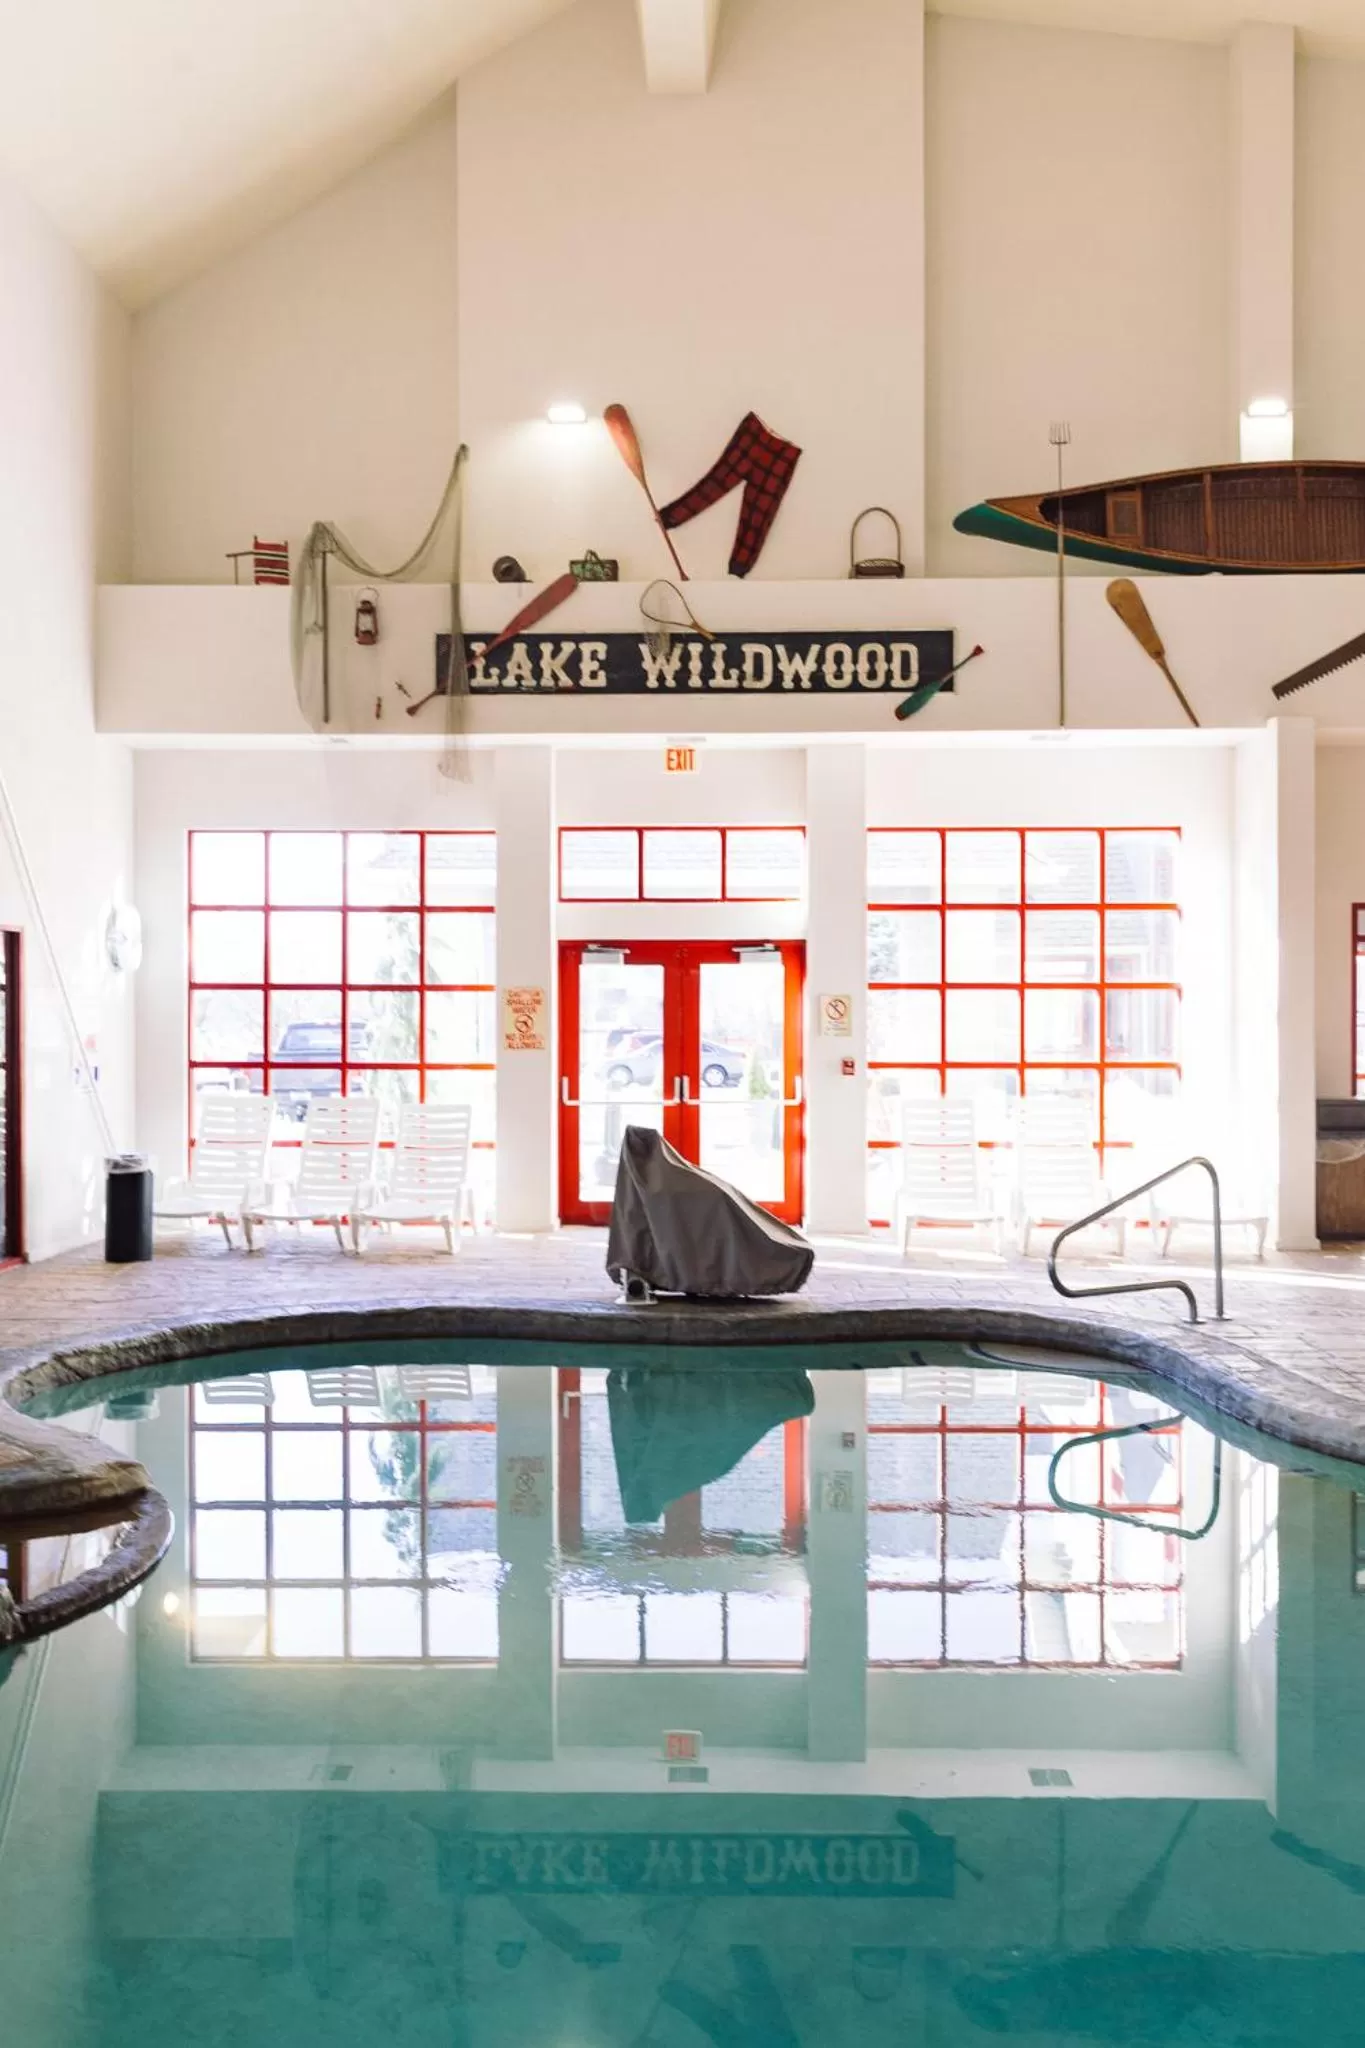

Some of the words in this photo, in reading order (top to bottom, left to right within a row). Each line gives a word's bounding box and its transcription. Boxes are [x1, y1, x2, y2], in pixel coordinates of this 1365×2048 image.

[470, 641, 608, 688] LAKE
[638, 642, 919, 690] WILDWOOD
[666, 748, 695, 771] EXIT
